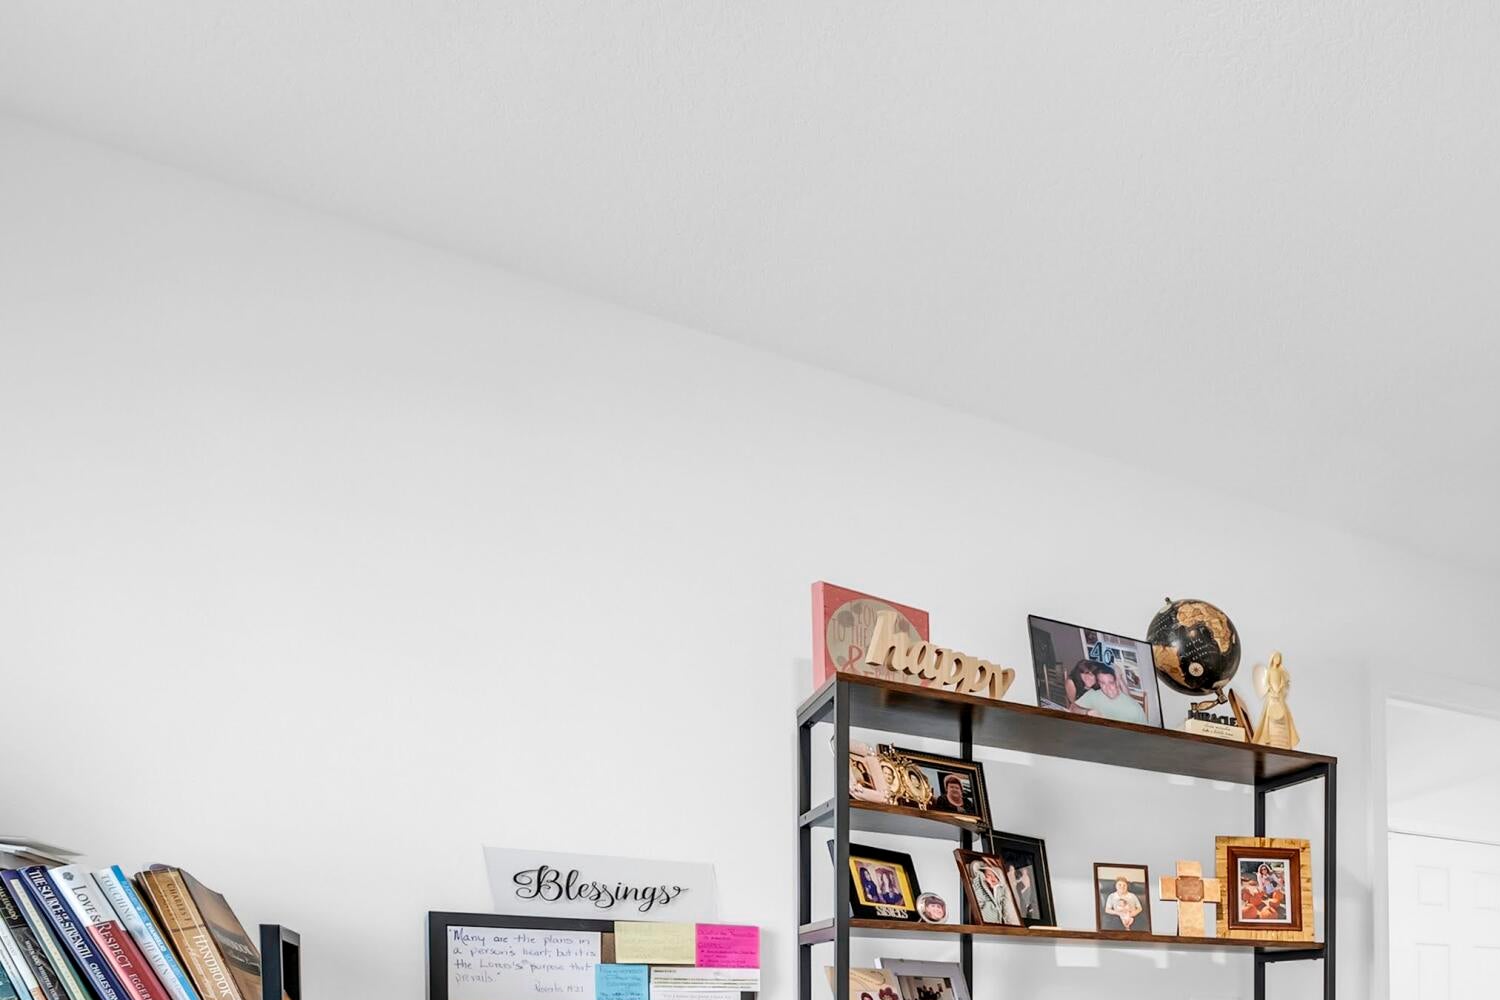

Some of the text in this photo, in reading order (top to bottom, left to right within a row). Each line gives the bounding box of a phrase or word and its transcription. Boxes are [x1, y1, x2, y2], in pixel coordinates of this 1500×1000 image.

[865, 609, 1015, 698] happy
[513, 865, 690, 912] Blessings
[71, 884, 99, 917] LOVE
[94, 919, 134, 970] RESPECT
[101, 873, 134, 922] TOUCHING
[142, 939, 170, 975] HEAVEN
[493, 935, 509, 943] are
[514, 933, 537, 944] the
[543, 935, 574, 950] plans
[89, 962, 111, 989] CHARLES
[192, 934, 232, 999] HANDBOOK
[453, 947, 462, 955] a
[556, 948, 571, 957] but
[454, 958, 472, 969] the
[569, 960, 592, 972] that
